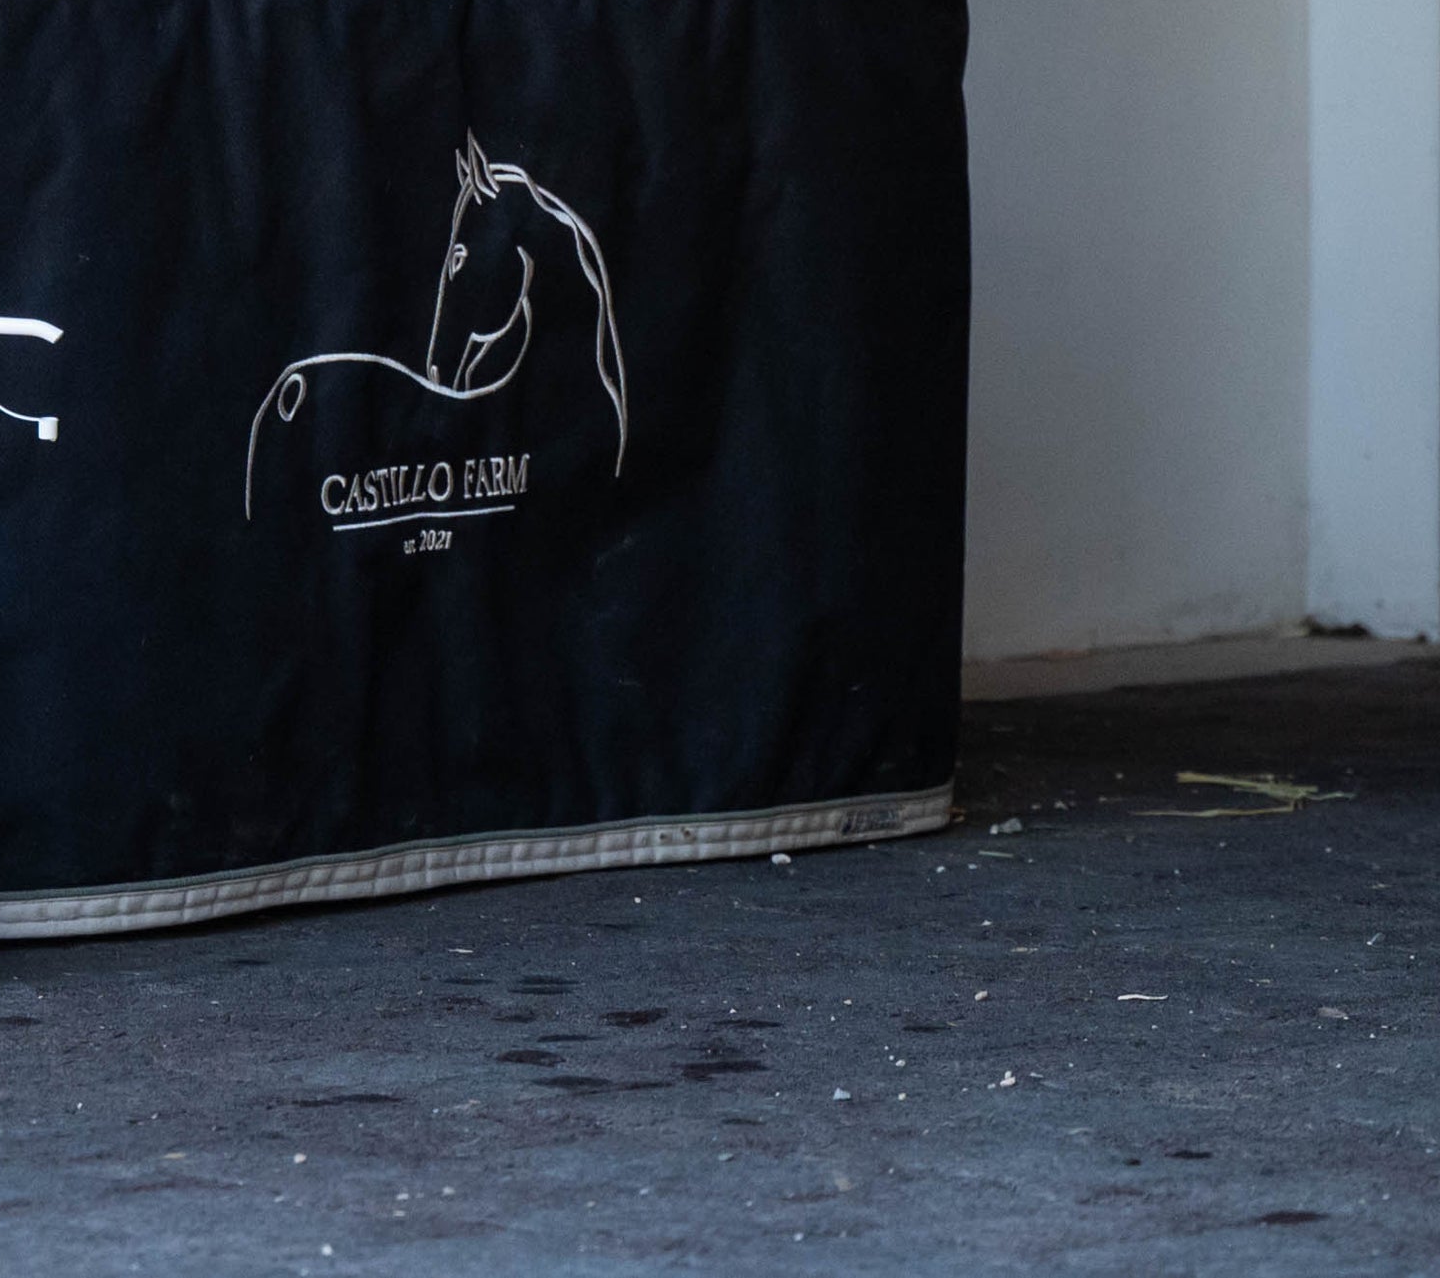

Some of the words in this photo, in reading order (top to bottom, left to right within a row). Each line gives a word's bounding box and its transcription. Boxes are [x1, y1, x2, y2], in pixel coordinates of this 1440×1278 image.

[321, 461, 455, 516] CASTILLO
[463, 453, 531, 500] FARM
[419, 529, 453, 552] 2021
